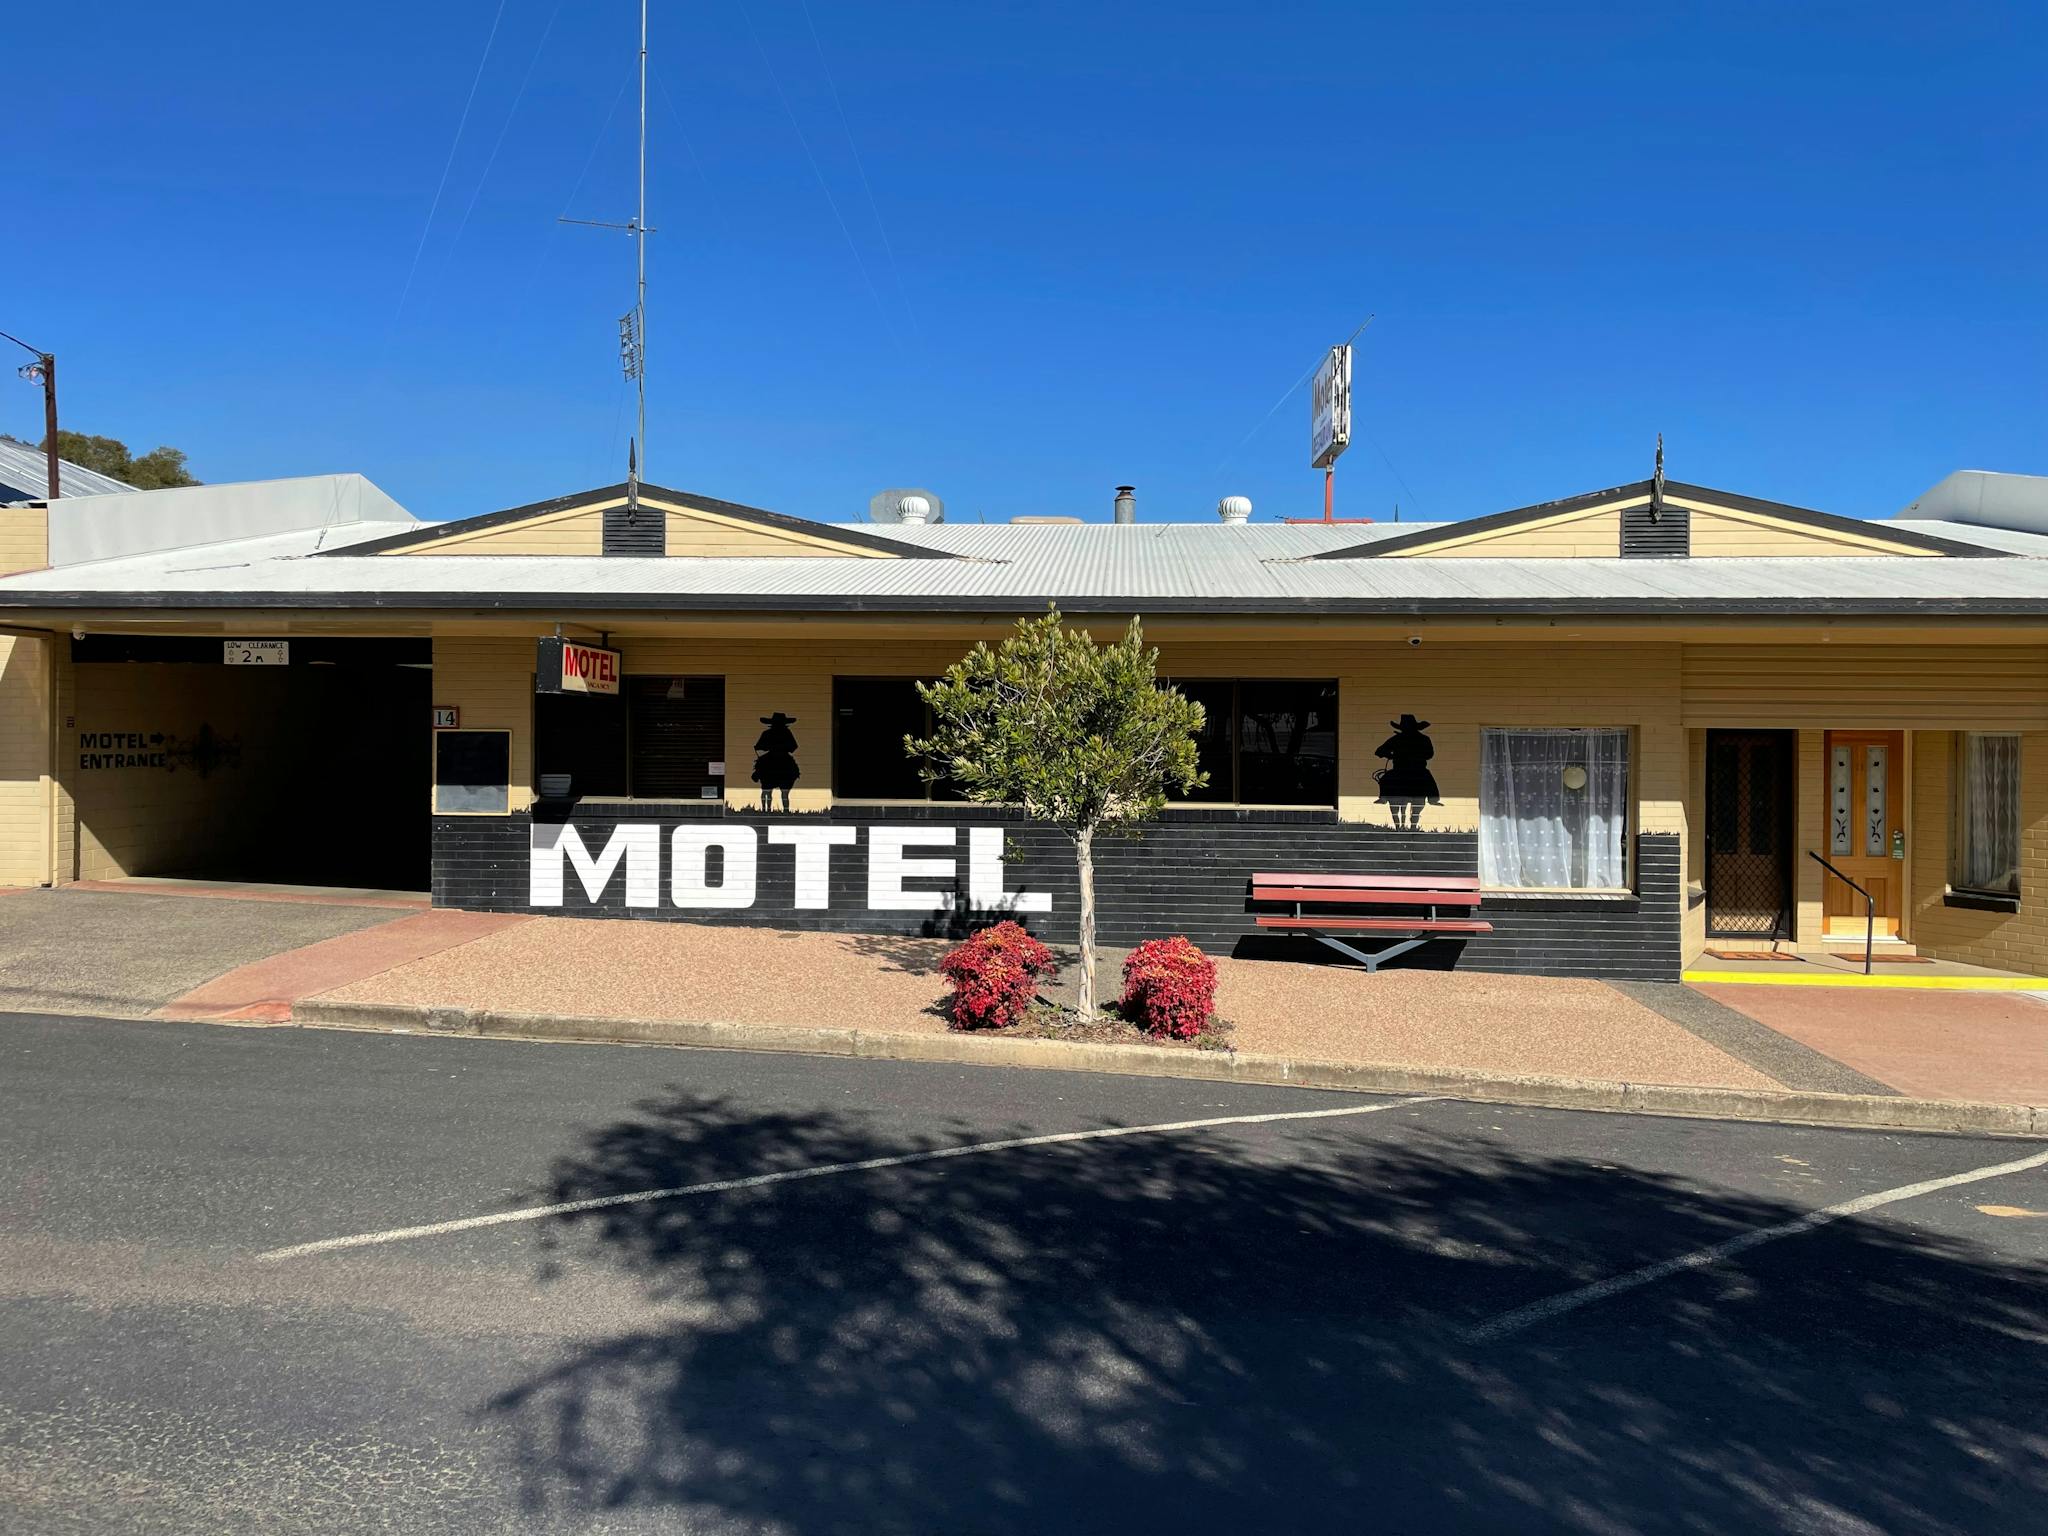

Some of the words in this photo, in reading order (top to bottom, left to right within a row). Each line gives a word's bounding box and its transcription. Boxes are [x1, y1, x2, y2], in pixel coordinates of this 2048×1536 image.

[242, 650, 251, 662] 2
[565, 646, 617, 682] MOTEL
[436, 711, 455, 726] 14
[80, 733, 148, 749] MOTEL
[80, 752, 166, 770] ENTRANCE
[529, 823, 1053, 912] MOTEL
